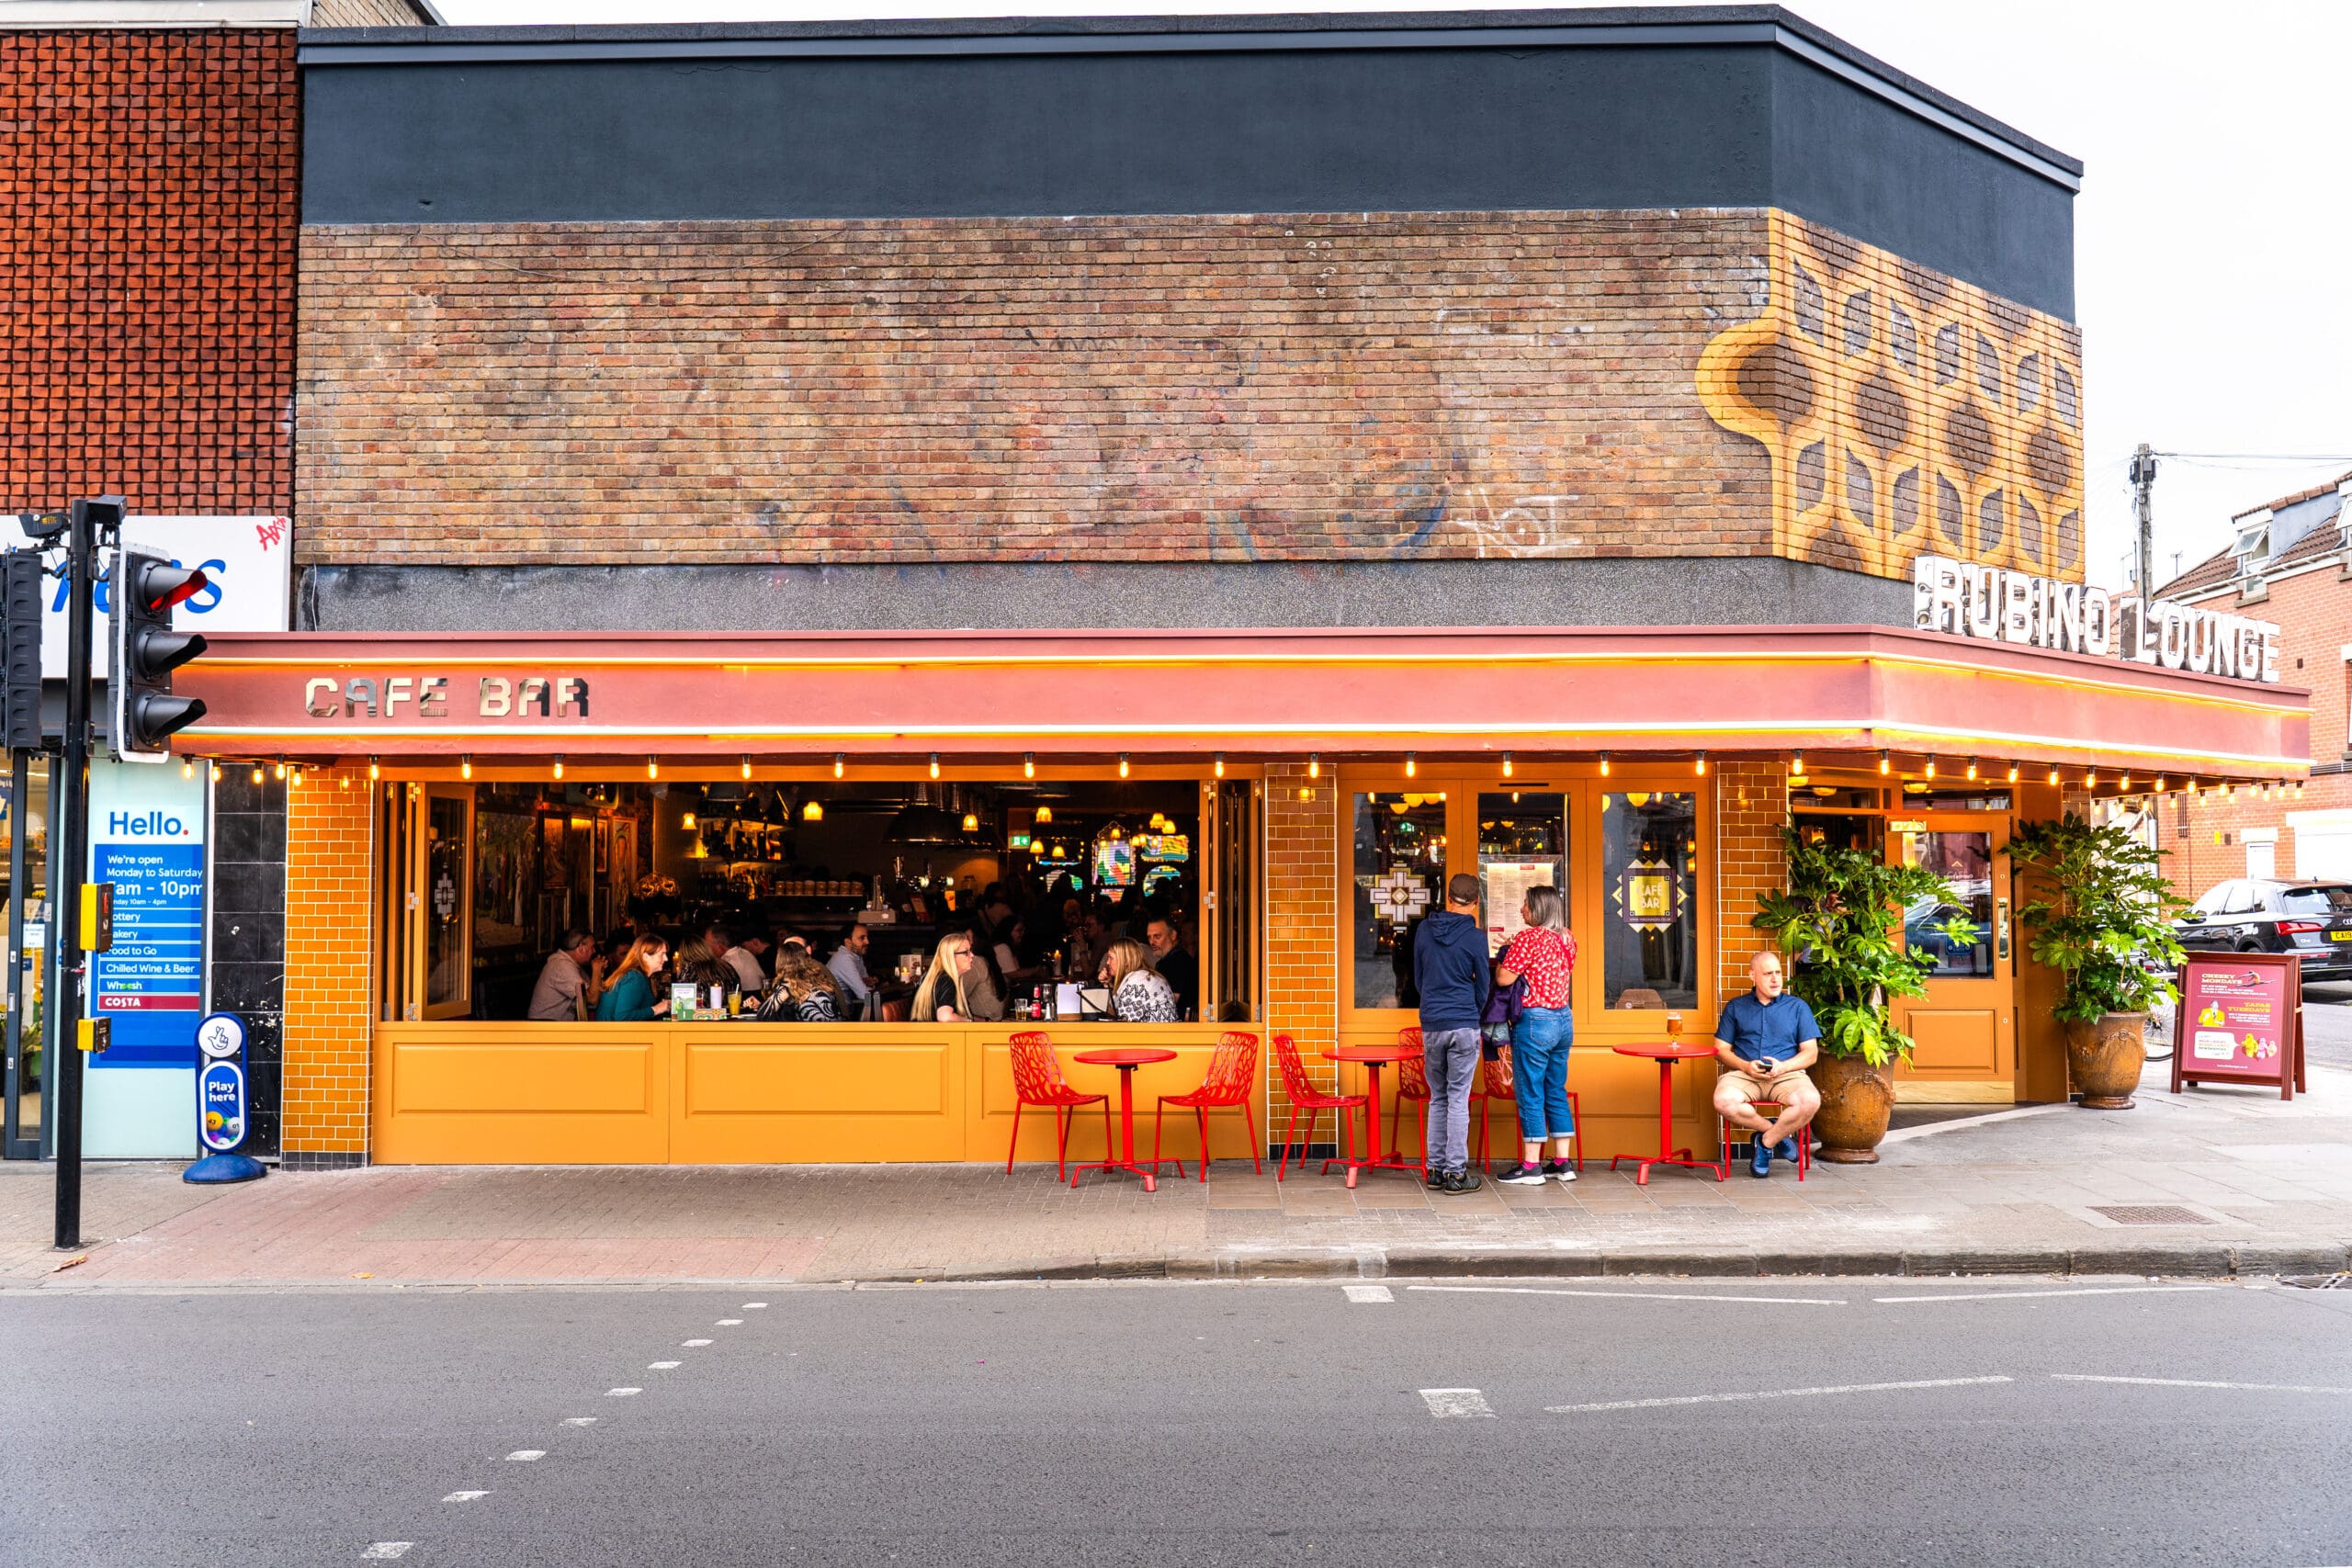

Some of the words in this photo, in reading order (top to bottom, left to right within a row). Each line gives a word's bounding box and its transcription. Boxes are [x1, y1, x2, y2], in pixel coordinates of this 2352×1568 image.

[1915, 554, 2112, 657] RUBINO
[2120, 596, 2280, 683] LOUNGE
[306, 677, 448, 717] CAFE
[479, 677, 589, 717] BAR
[109, 811, 189, 836] Hello.
[138, 857, 164, 866] open
[107, 868, 144, 879] Monday
[146, 868, 156, 877] to
[158, 868, 203, 879] Saturday
[1640, 897, 1660, 908] BAR
[112, 913, 141, 922] ottery
[112, 930, 138, 940] akery
[131, 947, 141, 955] to
[143, 947, 157, 955] Go
[106, 964, 137, 973] Chilled
[139, 964, 163, 974] Wine
[173, 964, 196, 974] Beer
[105, 998, 141, 1007] COSTA
[209, 1081, 236, 1093] Play
[209, 1093, 236, 1102] here
